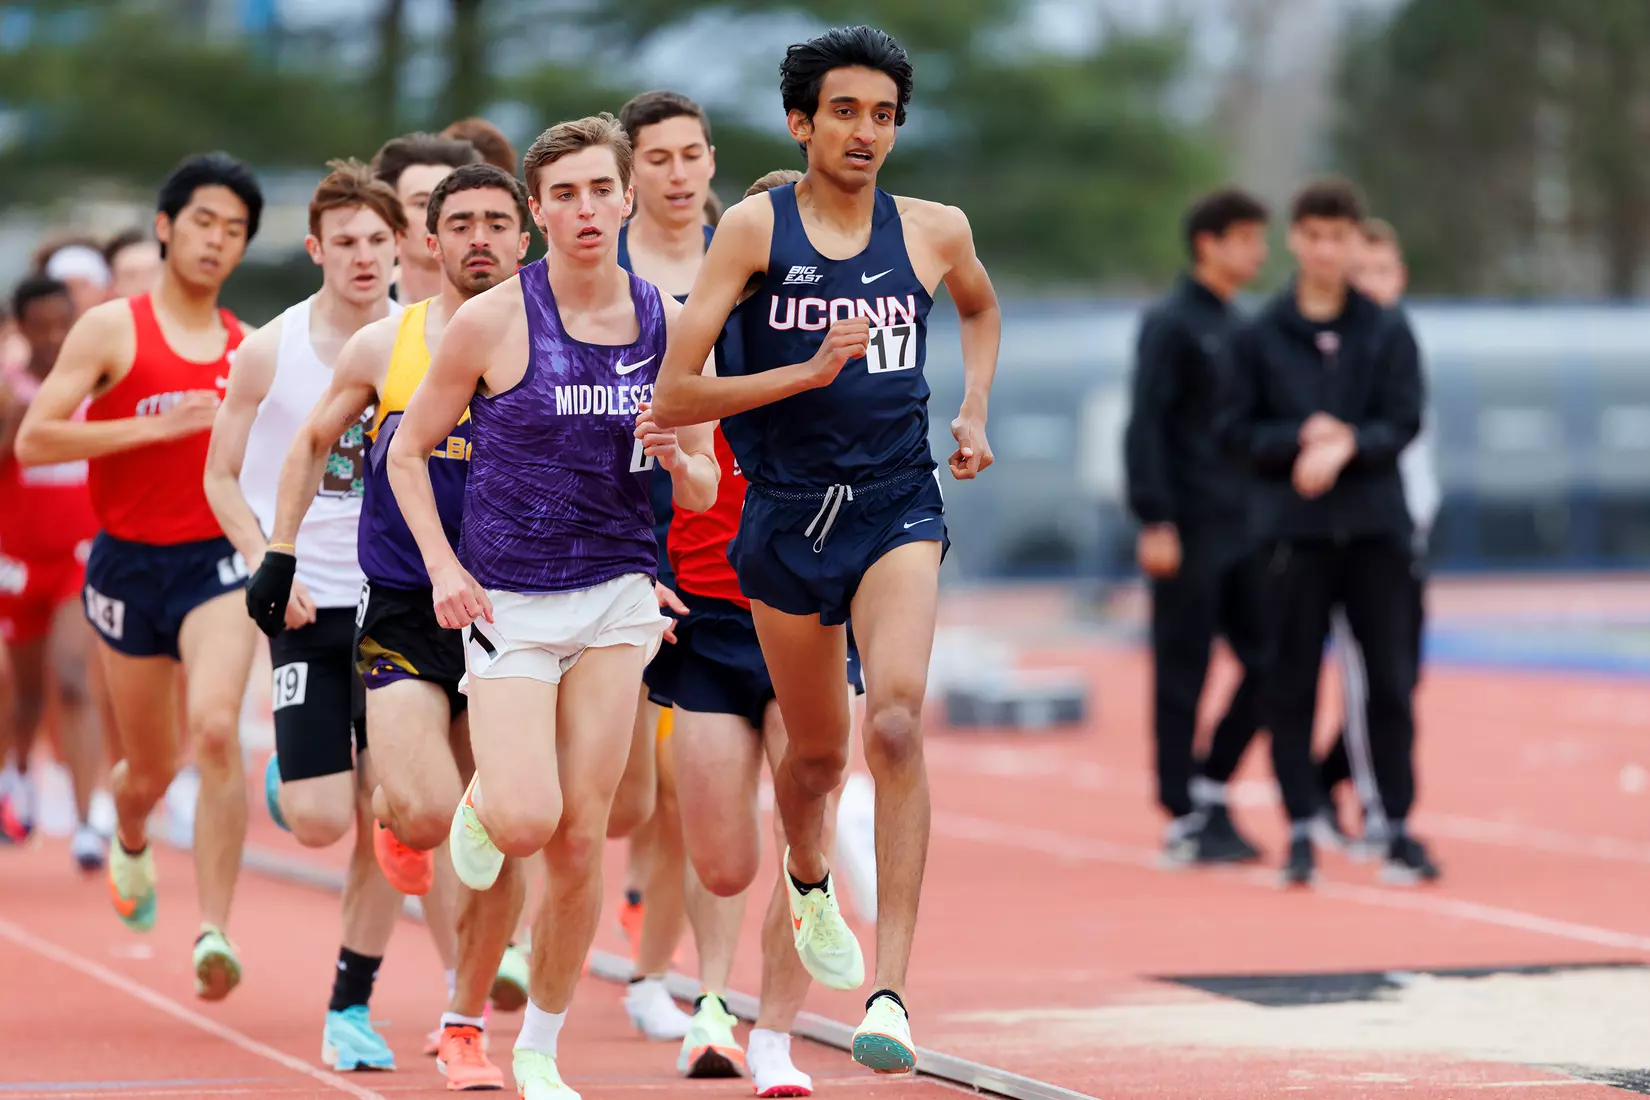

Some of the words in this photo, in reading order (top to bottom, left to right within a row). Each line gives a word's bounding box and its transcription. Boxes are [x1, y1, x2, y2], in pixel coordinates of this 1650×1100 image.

[784, 274, 824, 283] EAST
[788, 265, 818, 275] BIG
[768, 294, 916, 331] UCONN
[870, 326, 911, 370] 17
[275, 666, 299, 705] 19
